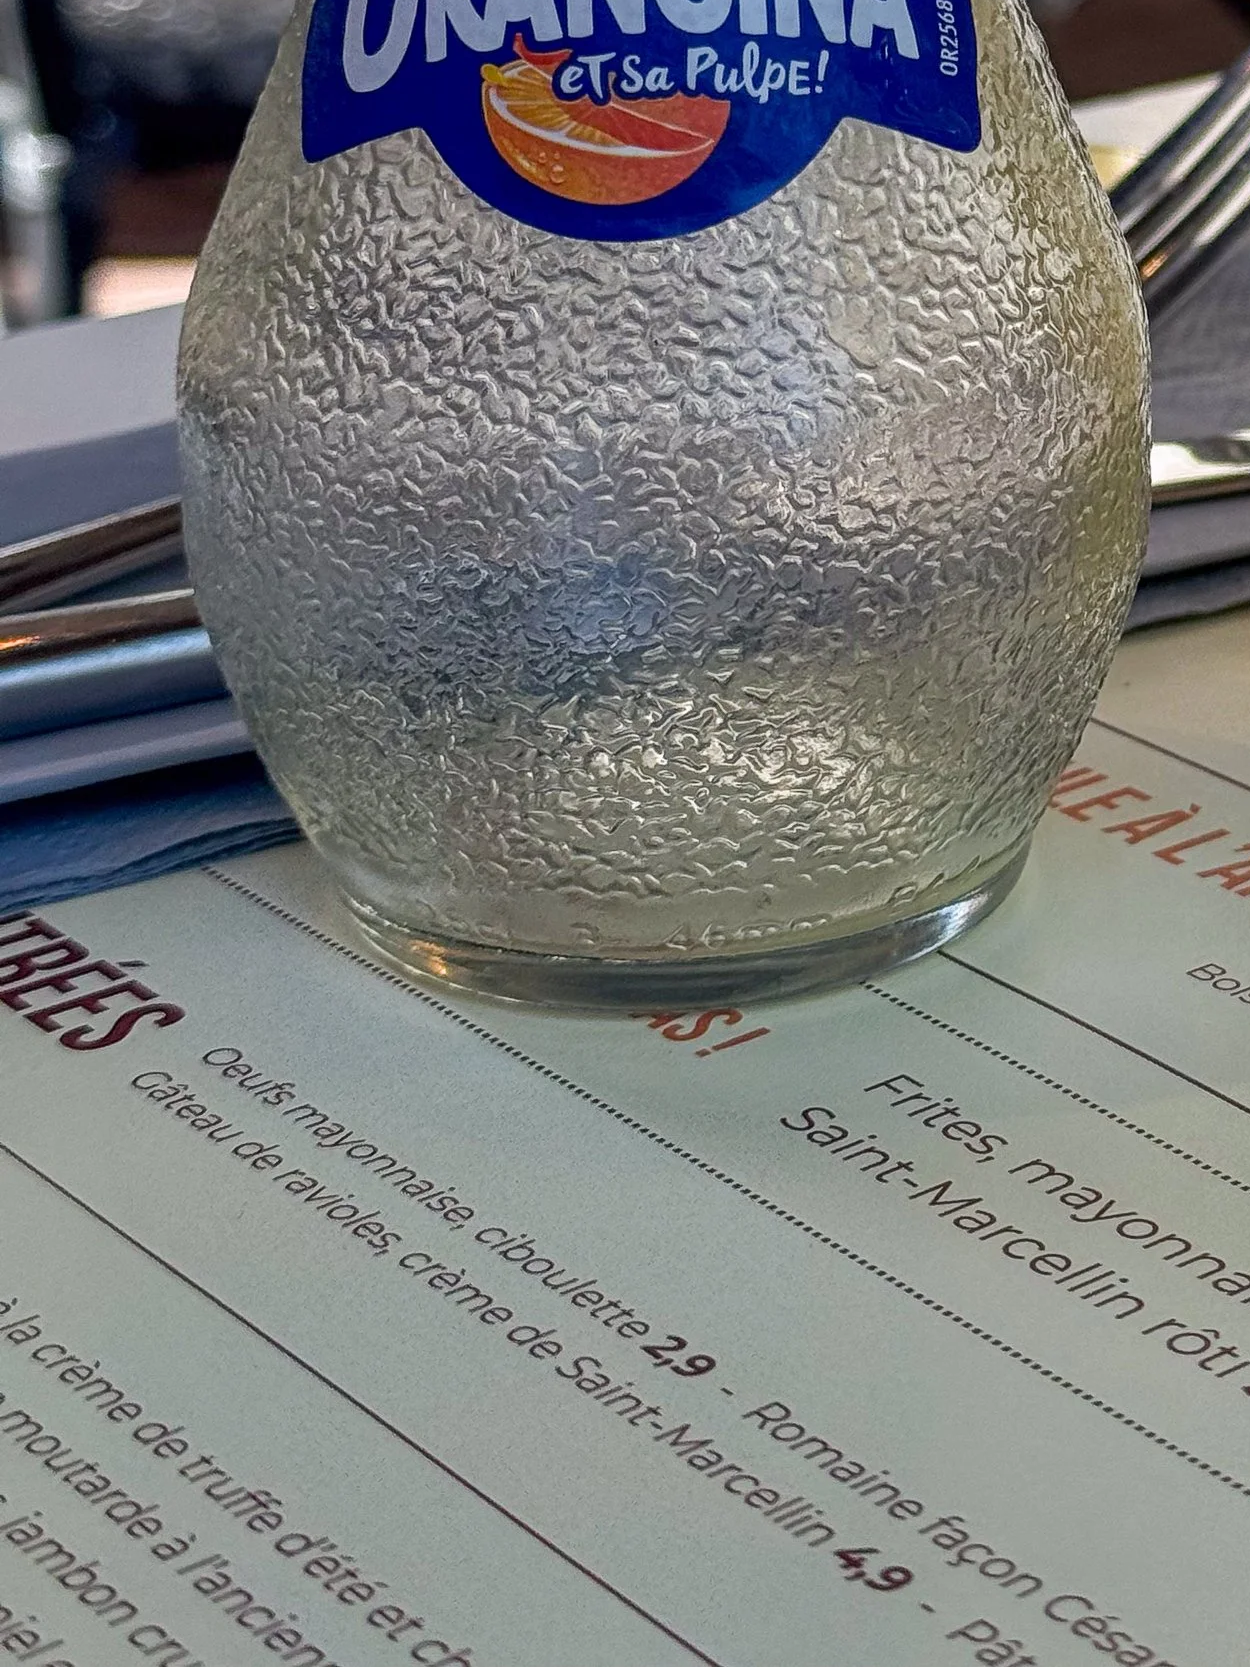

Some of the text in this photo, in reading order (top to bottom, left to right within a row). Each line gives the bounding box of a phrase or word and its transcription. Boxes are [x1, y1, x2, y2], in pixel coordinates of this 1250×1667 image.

[1100, 802, 1202, 844] À
[0, 909, 186, 1051] TRÉES
[779, 1104, 1146, 1321] Saint-Marcellin
[863, 1071, 1009, 1164] Frites,
[131, 1070, 244, 1144] Gâteau
[237, 1139, 284, 1172] de
[275, 1164, 402, 1258] ravioles,
[400, 1251, 514, 1326] crème
[508, 1322, 564, 1359] de
[556, 1354, 834, 1549] Saint-Marcellin
[833, 1546, 915, 1592] 4,9
[201, 1045, 294, 1108] Oeufs
[287, 1103, 473, 1231] mayonnaise,
[475, 1225, 650, 1339] ciboulette
[643, 1336, 717, 1380] 2,9
[741, 1401, 923, 1520] Romaine
[919, 1515, 1043, 1598] façon
[0, 1409, 340, 1667] moutarde à l'ancien
[31, 1343, 143, 1423] crème
[132, 1422, 189, 1458] de
[178, 1454, 283, 1533] truffe
[274, 1532, 390, 1605] d'été
[366, 1604, 425, 1642] et
